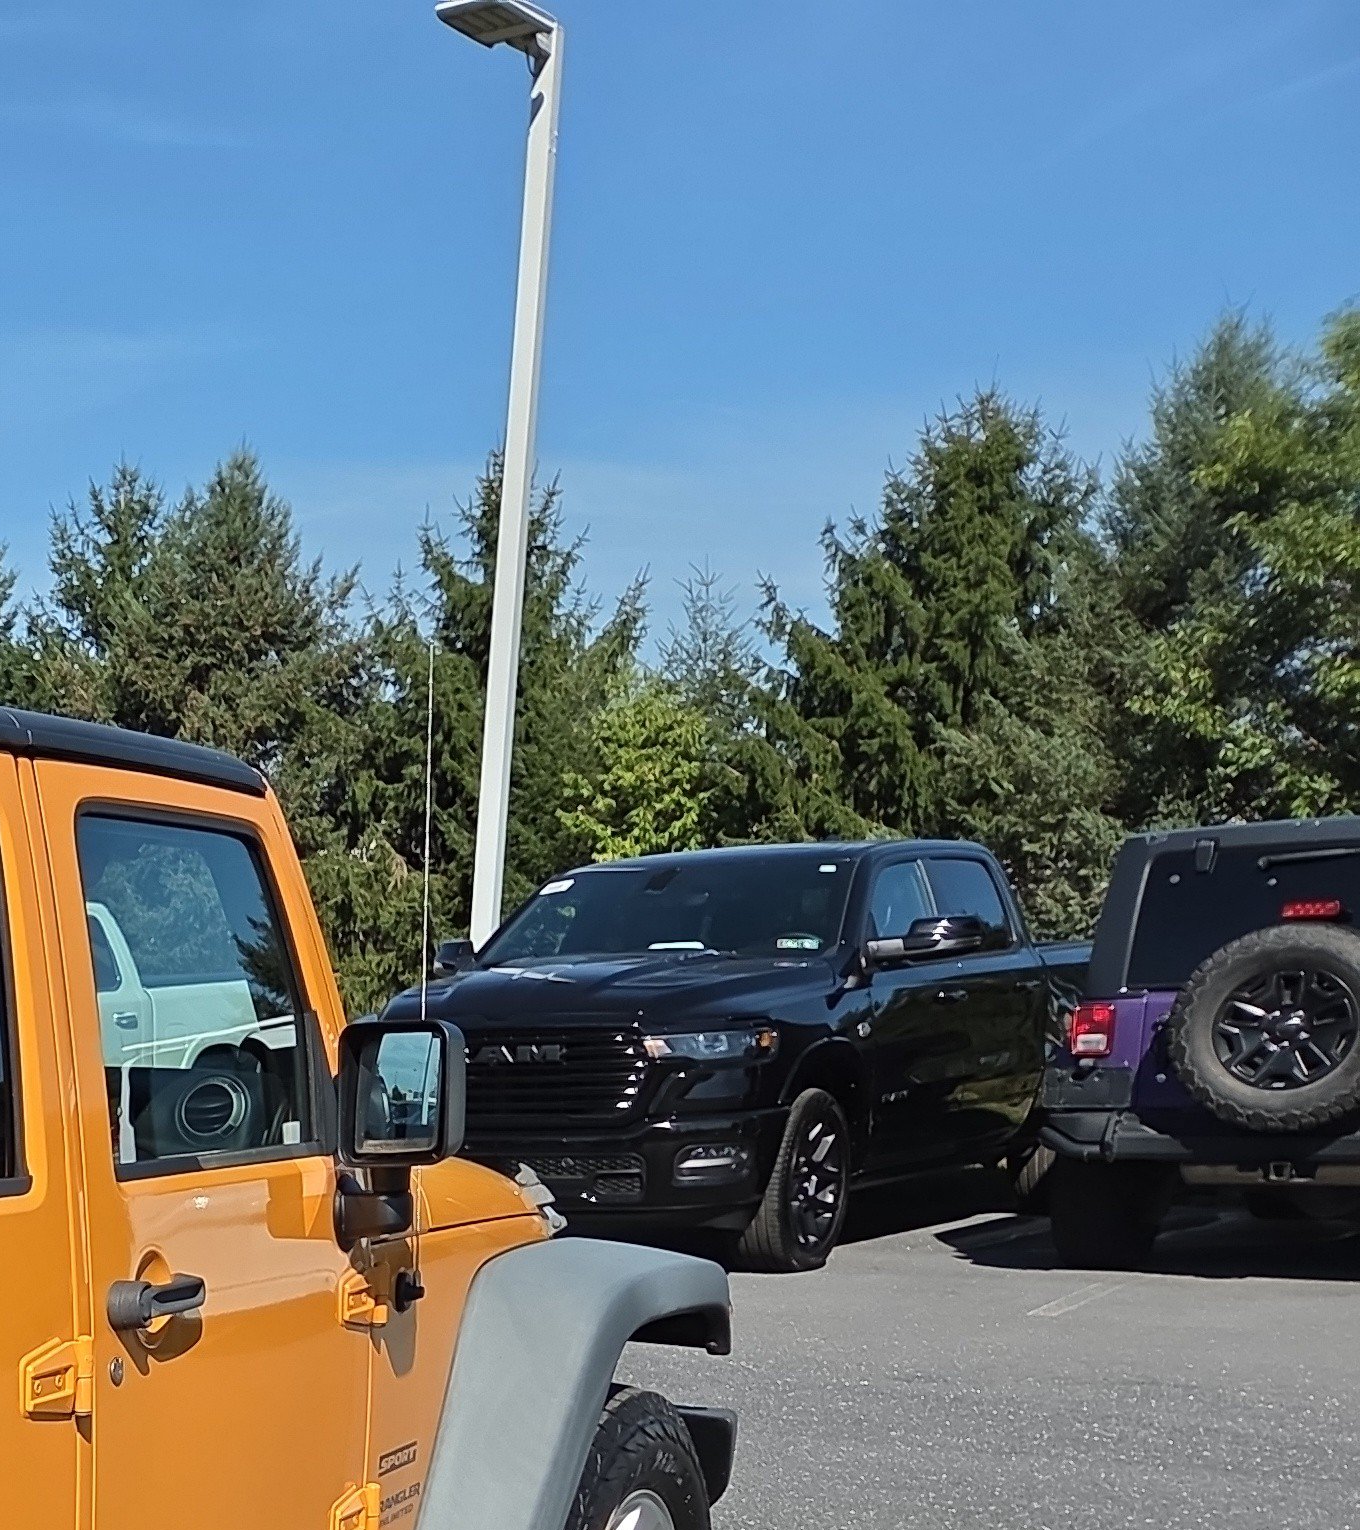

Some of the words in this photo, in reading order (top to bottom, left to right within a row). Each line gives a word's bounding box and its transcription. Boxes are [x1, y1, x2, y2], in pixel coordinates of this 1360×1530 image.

[464, 1044, 561, 1064] AM
[380, 1445, 418, 1473] SPORT
[380, 1482, 420, 1514] RANGLER
